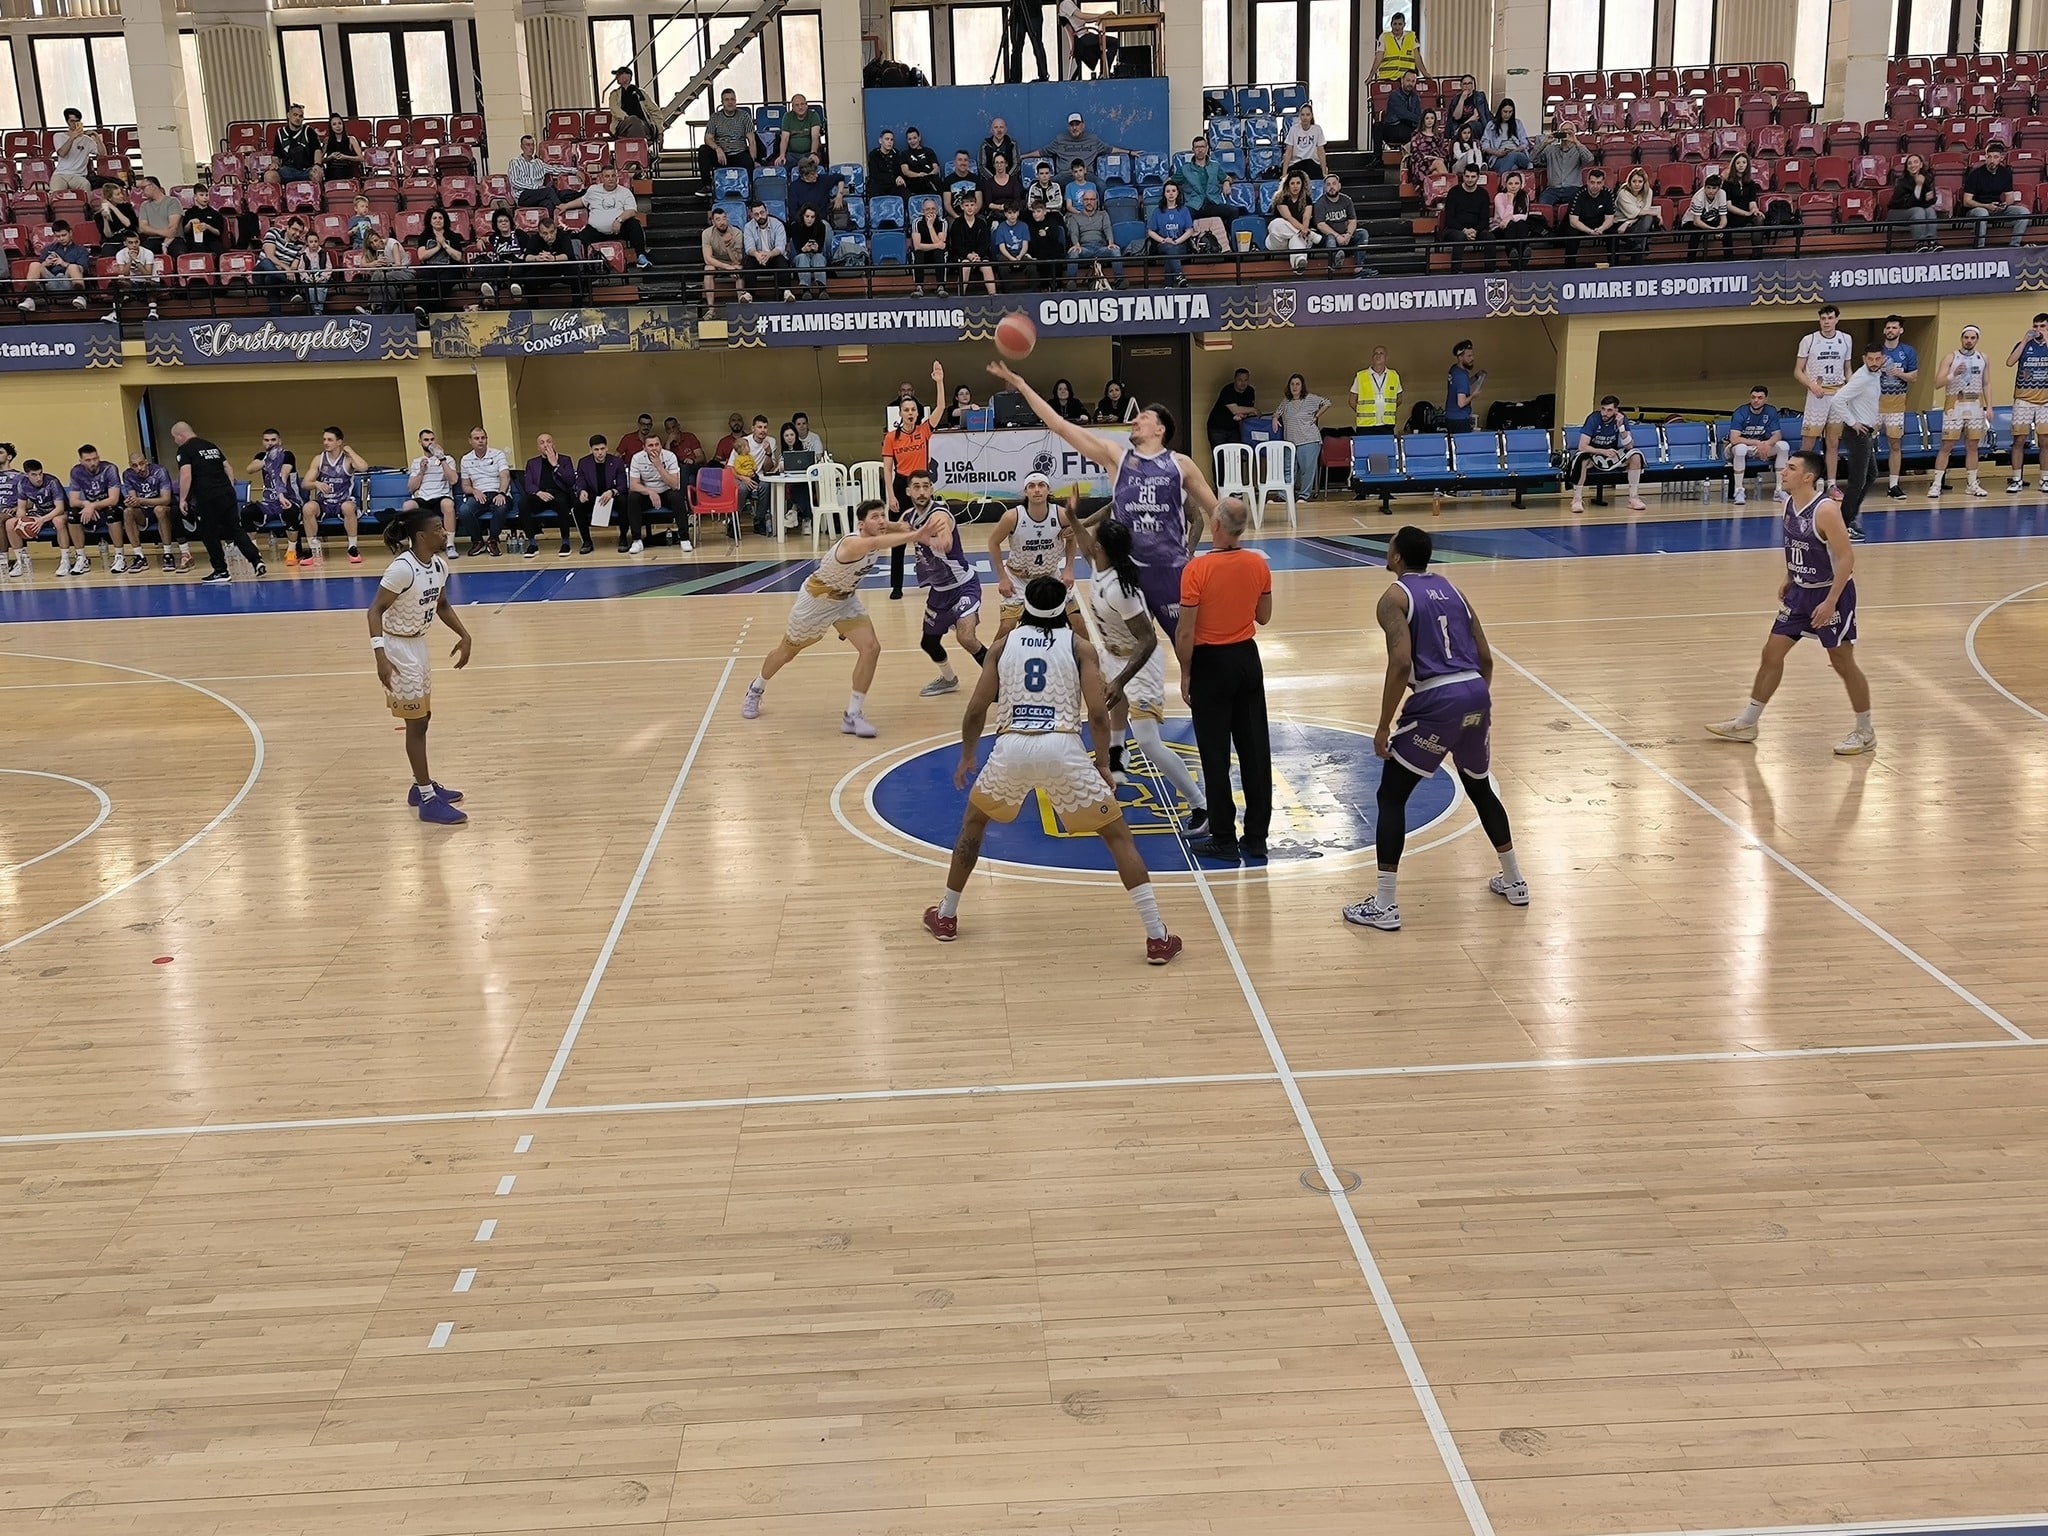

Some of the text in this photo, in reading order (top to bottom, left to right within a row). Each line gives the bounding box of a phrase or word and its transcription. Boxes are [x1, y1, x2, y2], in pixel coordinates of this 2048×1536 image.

[1829, 260, 2010, 288] #OSINGURAECHIPA
[1563, 275, 1748, 300] O MARE DE SPORTIVI
[1039, 294, 1211, 326] CONSTANȚA
[1307, 288, 1478, 314] CSM CONSTANȚA
[756, 309, 965, 333] #TEAMISEVERYTHING
[212, 320, 351, 360] Constangeles
[0, 342, 76, 357] tanta.ro
[1824, 365, 1834, 374] 11
[944, 460, 974, 472] LIGA
[945, 471, 1017, 484] ZIMBRILOR
[141, 483, 152, 493] 22
[1139, 485, 1156, 504] 26
[1034, 554, 1044, 566] 4
[1791, 547, 1804, 566] 10
[1425, 589, 1449, 600] HILL
[423, 607, 434, 625] 15
[1020, 636, 1056, 649] TONEY
[1437, 615, 1452, 660] 1
[1024, 658, 1047, 692] 8
[403, 703, 420, 711] CSU
